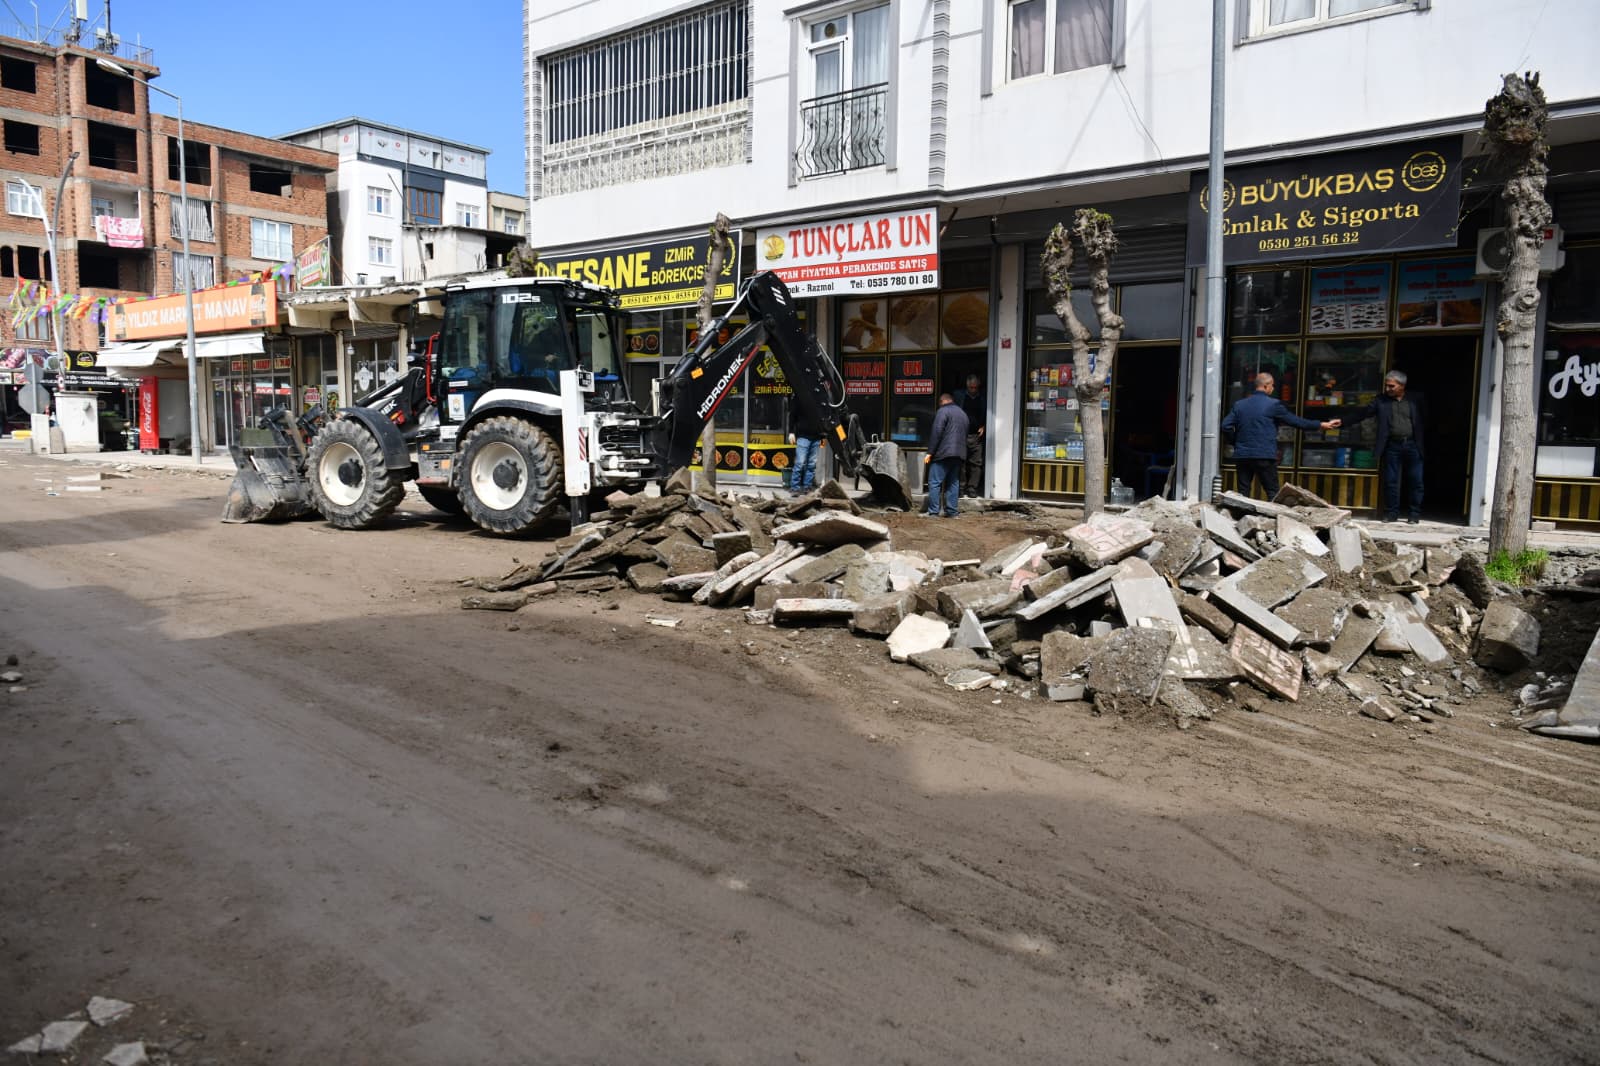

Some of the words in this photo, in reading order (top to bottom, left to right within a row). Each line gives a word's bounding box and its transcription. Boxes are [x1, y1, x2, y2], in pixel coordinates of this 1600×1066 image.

[1240, 168, 1394, 206] BÜYÜKBAŞ
[1297, 209, 1317, 229] &
[1323, 201, 1420, 228] Sigorta
[789, 219, 892, 261] TUNÇLAR
[899, 213, 932, 246] UN
[1259, 236, 1290, 251] 0530
[1294, 234, 1317, 248] 251
[1322, 233, 1339, 245] 56
[1343, 231, 1360, 244] 32
[664, 245, 694, 264] İZMİR
[842, 261, 897, 275] PERAKENDE
[899, 258, 928, 271] SATIŞ
[867, 277, 888, 288] 0535
[890, 275, 907, 286] 780
[909, 275, 919, 285] 01
[922, 274, 934, 284] 80
[127, 309, 160, 329] YILDIZ
[205, 297, 249, 320] MANAV
